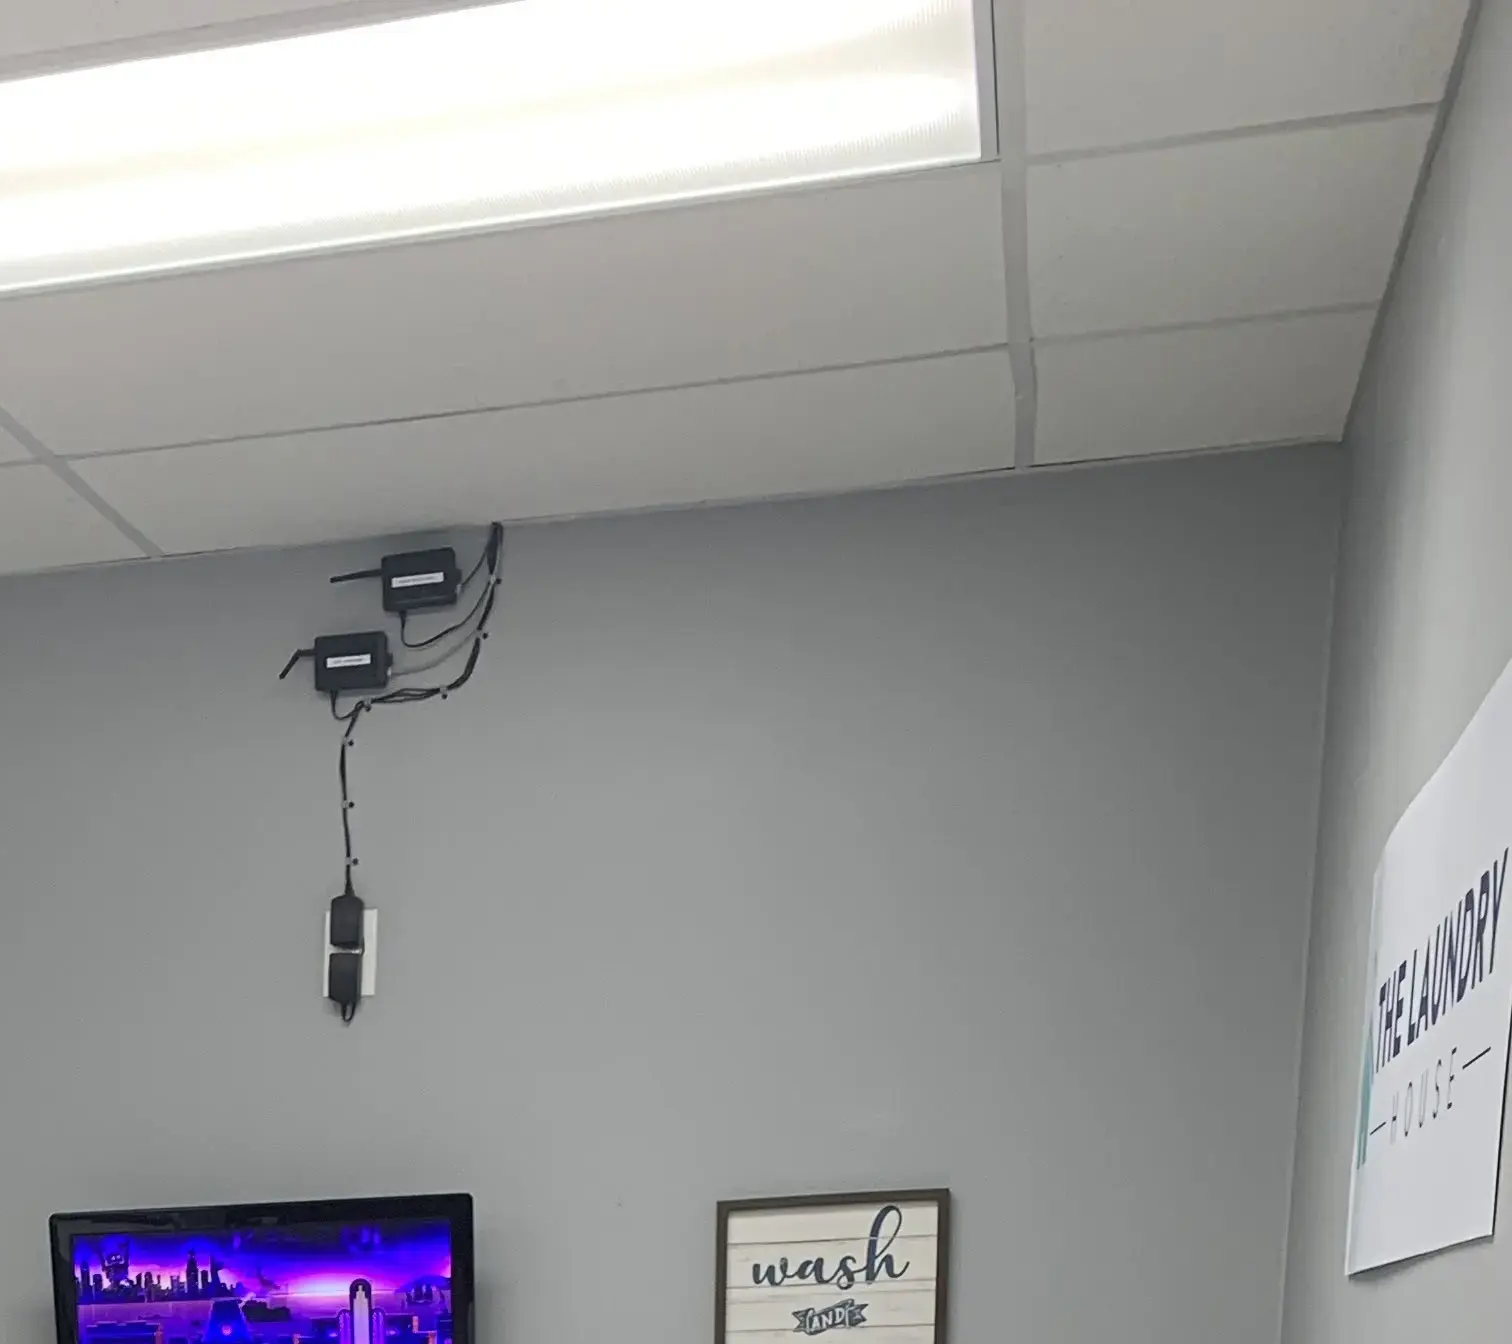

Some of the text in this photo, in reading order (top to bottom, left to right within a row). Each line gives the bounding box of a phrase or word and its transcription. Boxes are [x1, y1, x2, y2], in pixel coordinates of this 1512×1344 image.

[1376, 847, 1509, 1073] THE LAUNDRY
[1390, 1047, 1457, 1145] HOUSE
[752, 1205, 910, 1290] wash
[811, 1308, 846, 1330] AND
